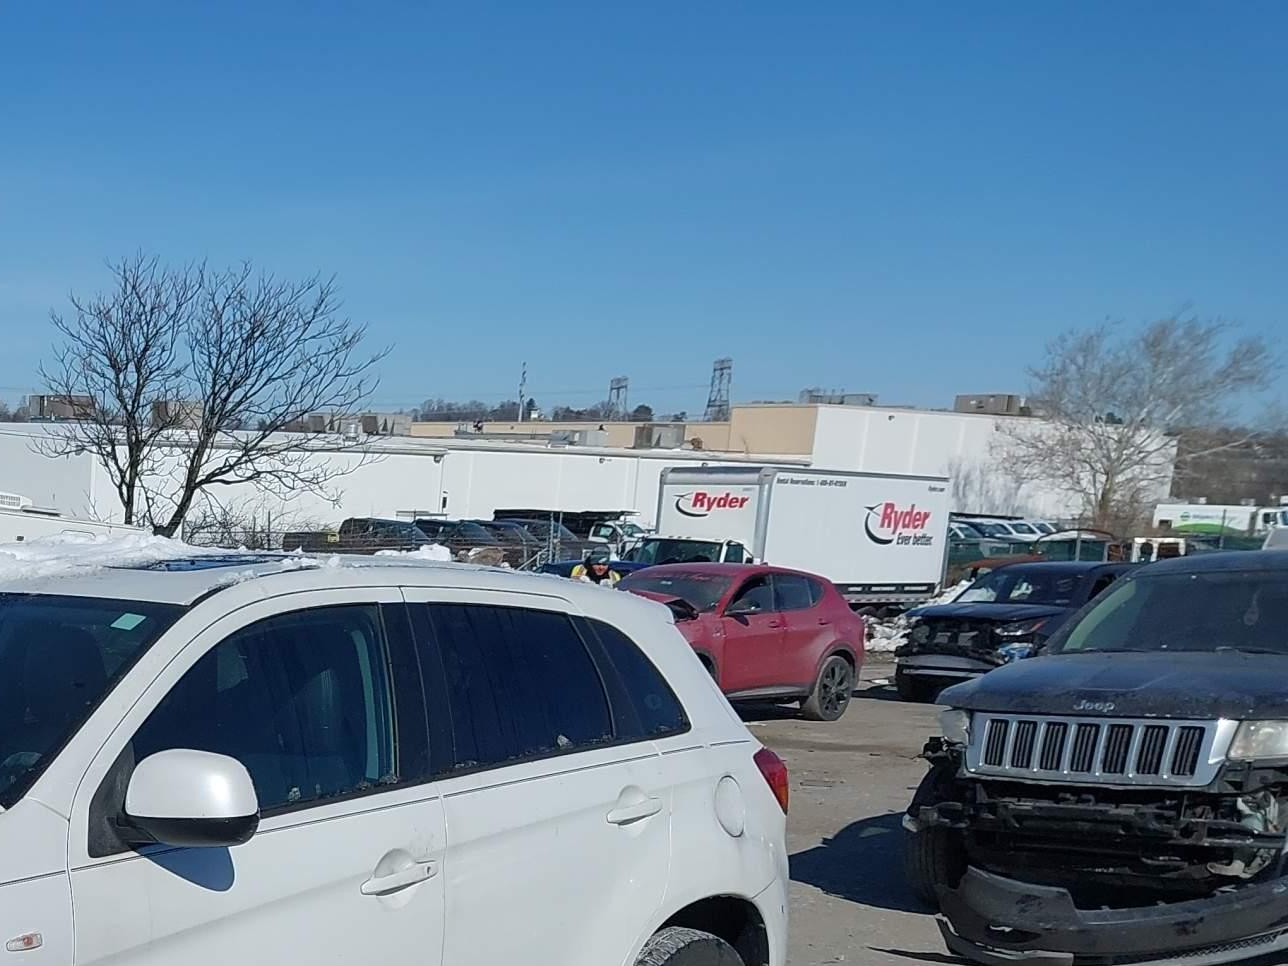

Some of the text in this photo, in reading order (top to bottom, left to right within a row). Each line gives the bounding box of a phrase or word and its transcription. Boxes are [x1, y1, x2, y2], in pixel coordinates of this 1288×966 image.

[692, 492, 750, 511] Ryder
[880, 503, 931, 535] Ryder
[896, 533, 912, 546] Ever
[1073, 699, 1115, 713] Jeep
